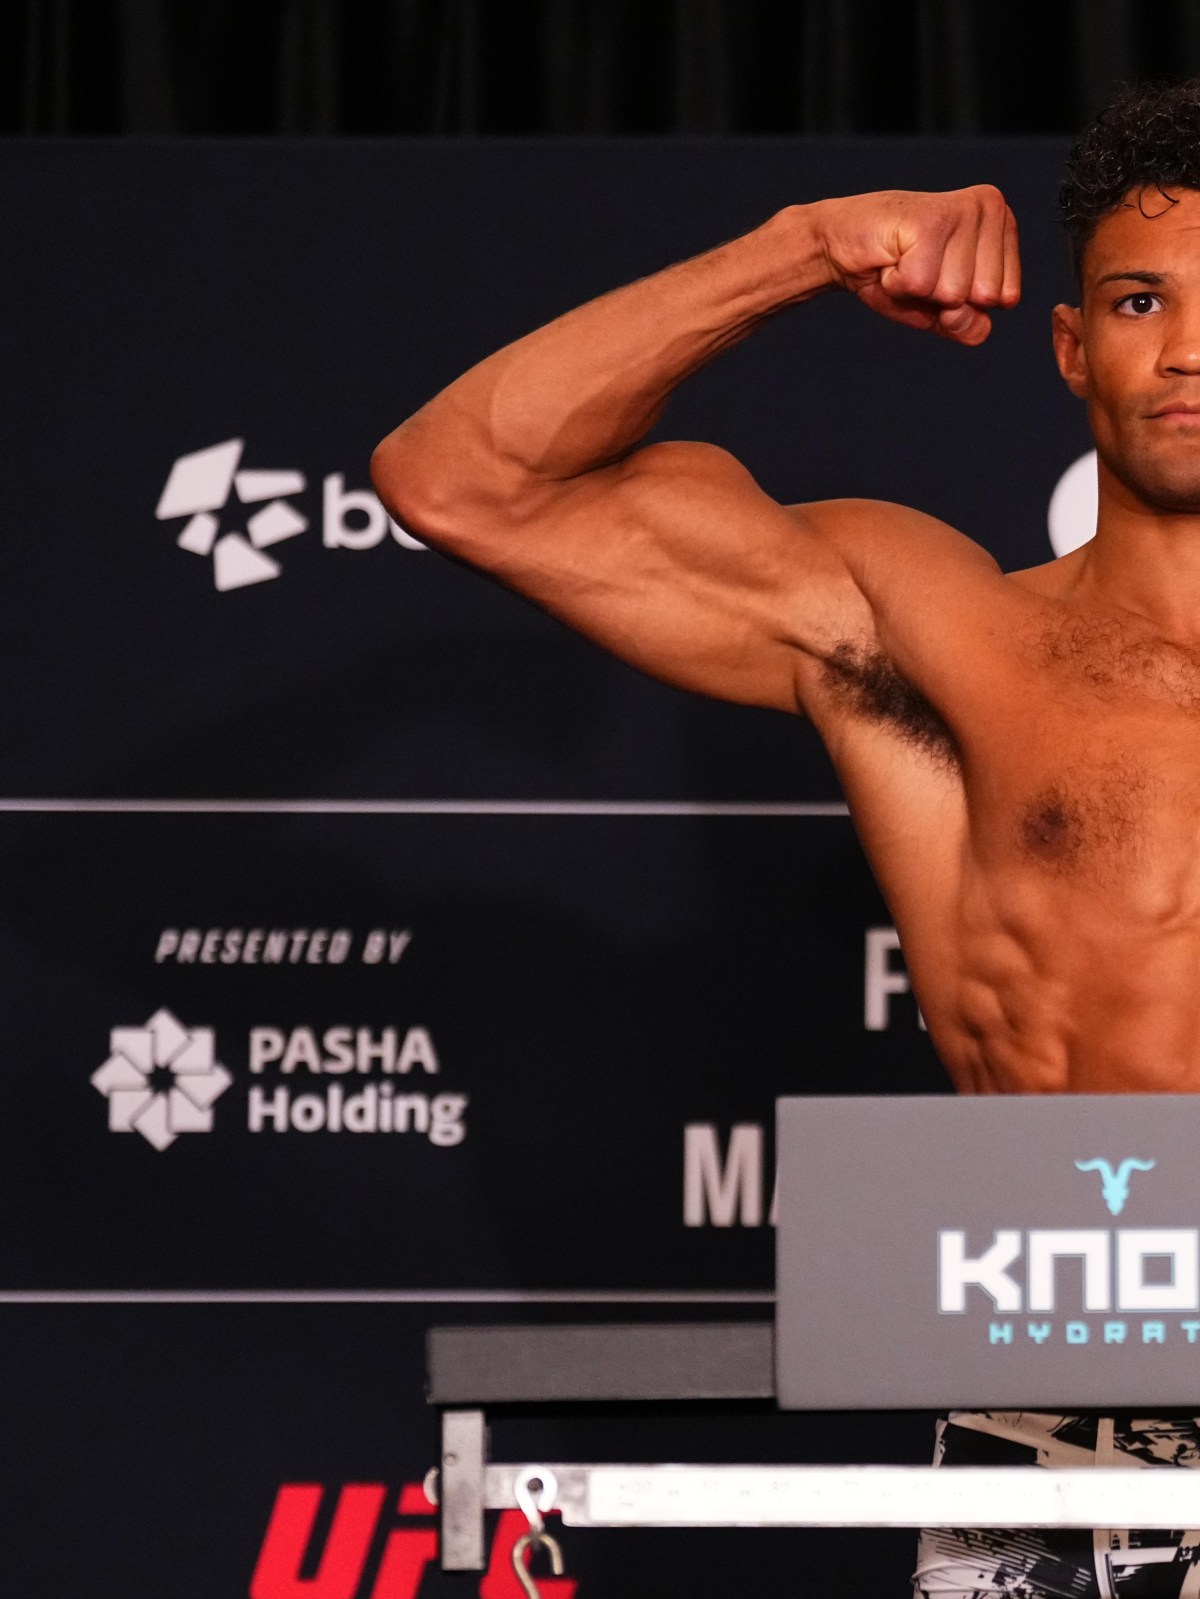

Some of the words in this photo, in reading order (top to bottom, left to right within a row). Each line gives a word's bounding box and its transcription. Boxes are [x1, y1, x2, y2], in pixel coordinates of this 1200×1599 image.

[155, 929, 351, 964] PRESENTED
[362, 929, 412, 964] BY
[248, 1026, 438, 1075] PASHA
[247, 1081, 468, 1147] Holding
